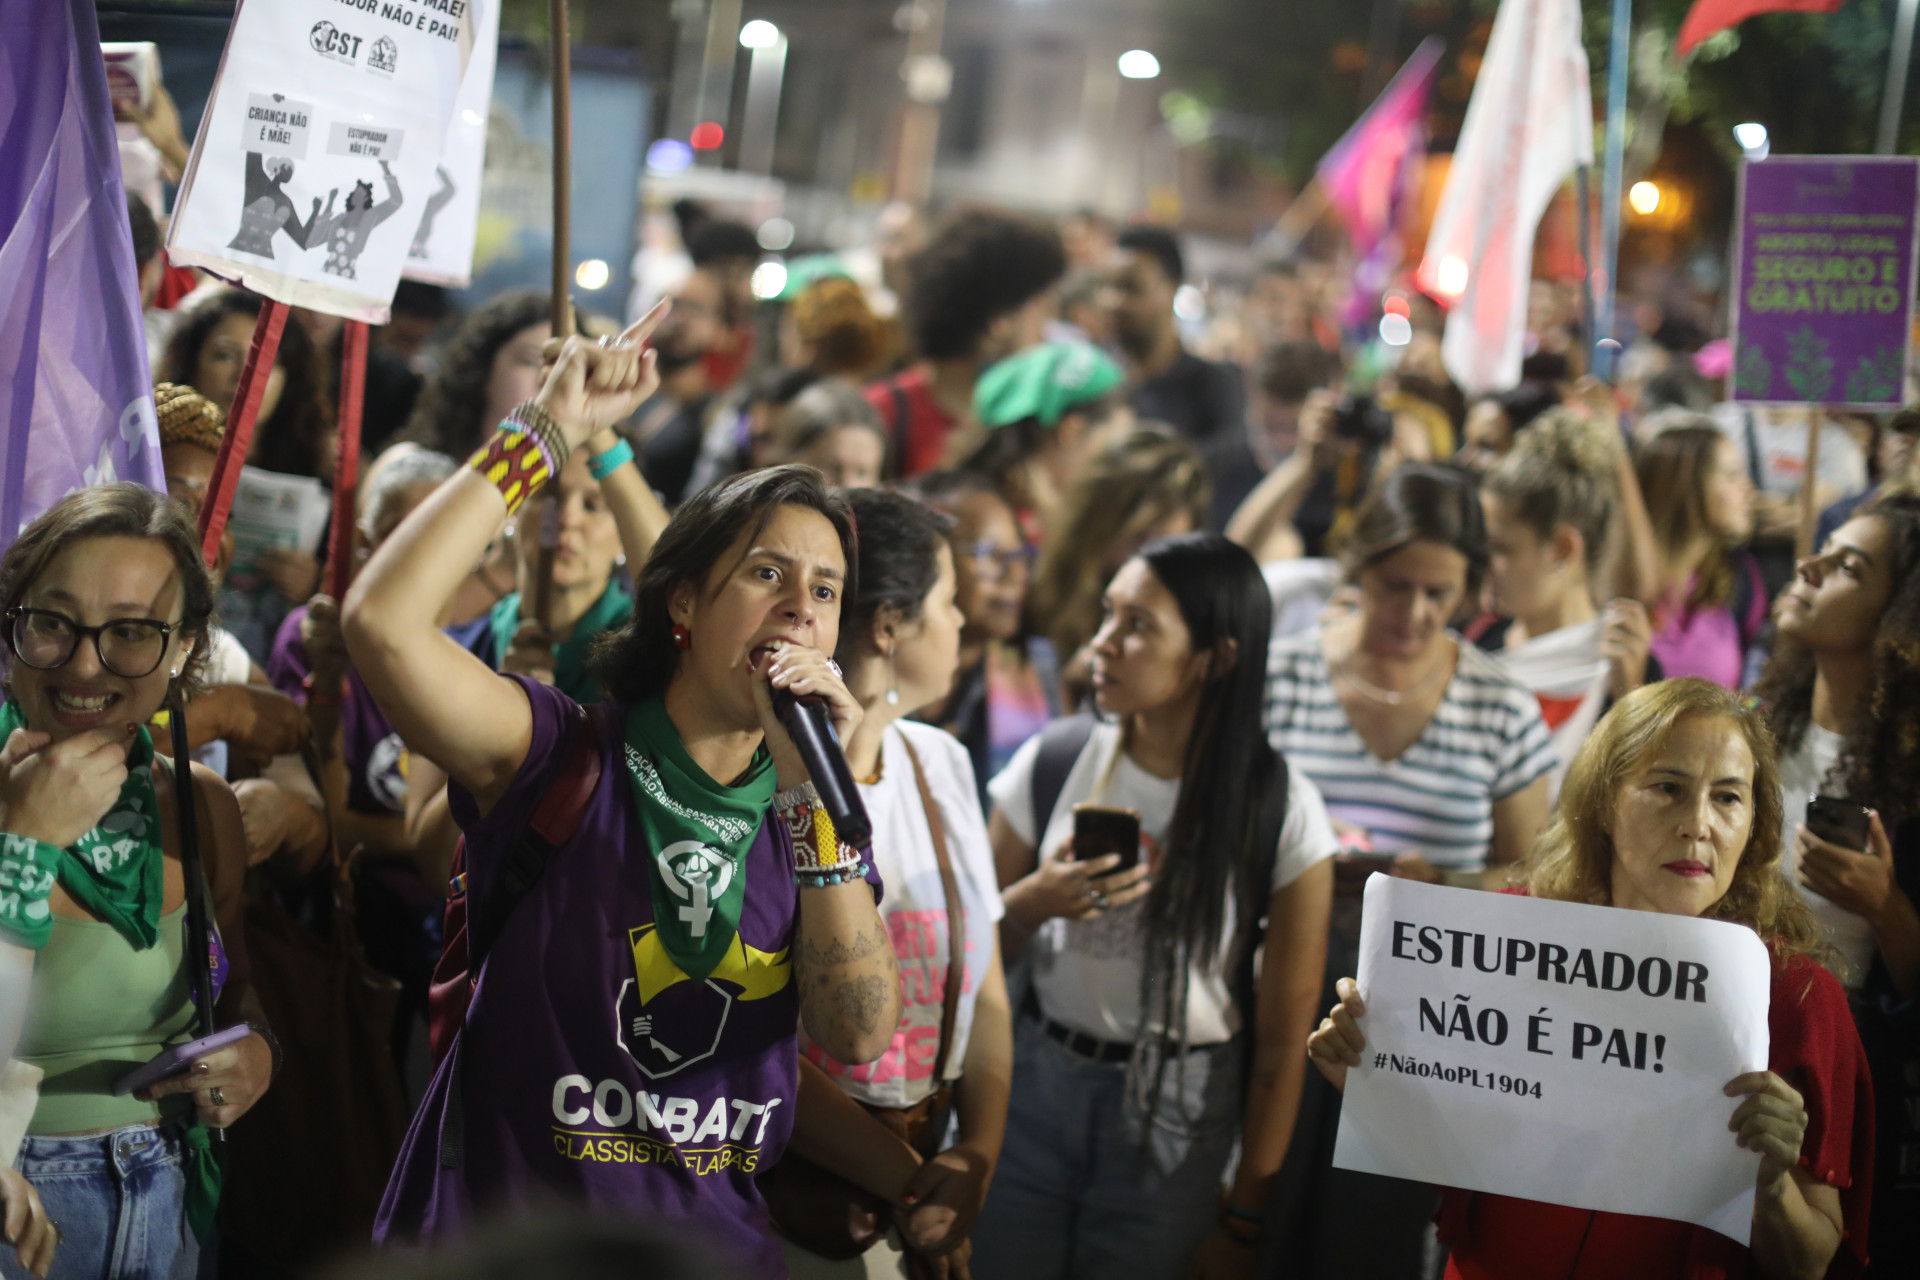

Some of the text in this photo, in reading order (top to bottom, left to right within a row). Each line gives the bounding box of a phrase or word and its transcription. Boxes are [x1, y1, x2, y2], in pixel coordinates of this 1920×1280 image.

[381, 3, 413, 26] NÃO
[416, 12, 427, 30] É
[428, 19, 459, 42] PAI!
[326, 28, 363, 59] CST
[248, 106, 308, 129] CRIANÇA NÃO
[259, 126, 266, 141] É
[1748, 284, 1900, 314] GRATUITO
[1392, 920, 1709, 1004] ESTUPRADOR
[1419, 993, 1666, 1074] NÃO É PAI!
[1374, 1052, 1543, 1099] #NãoAoPL1904
